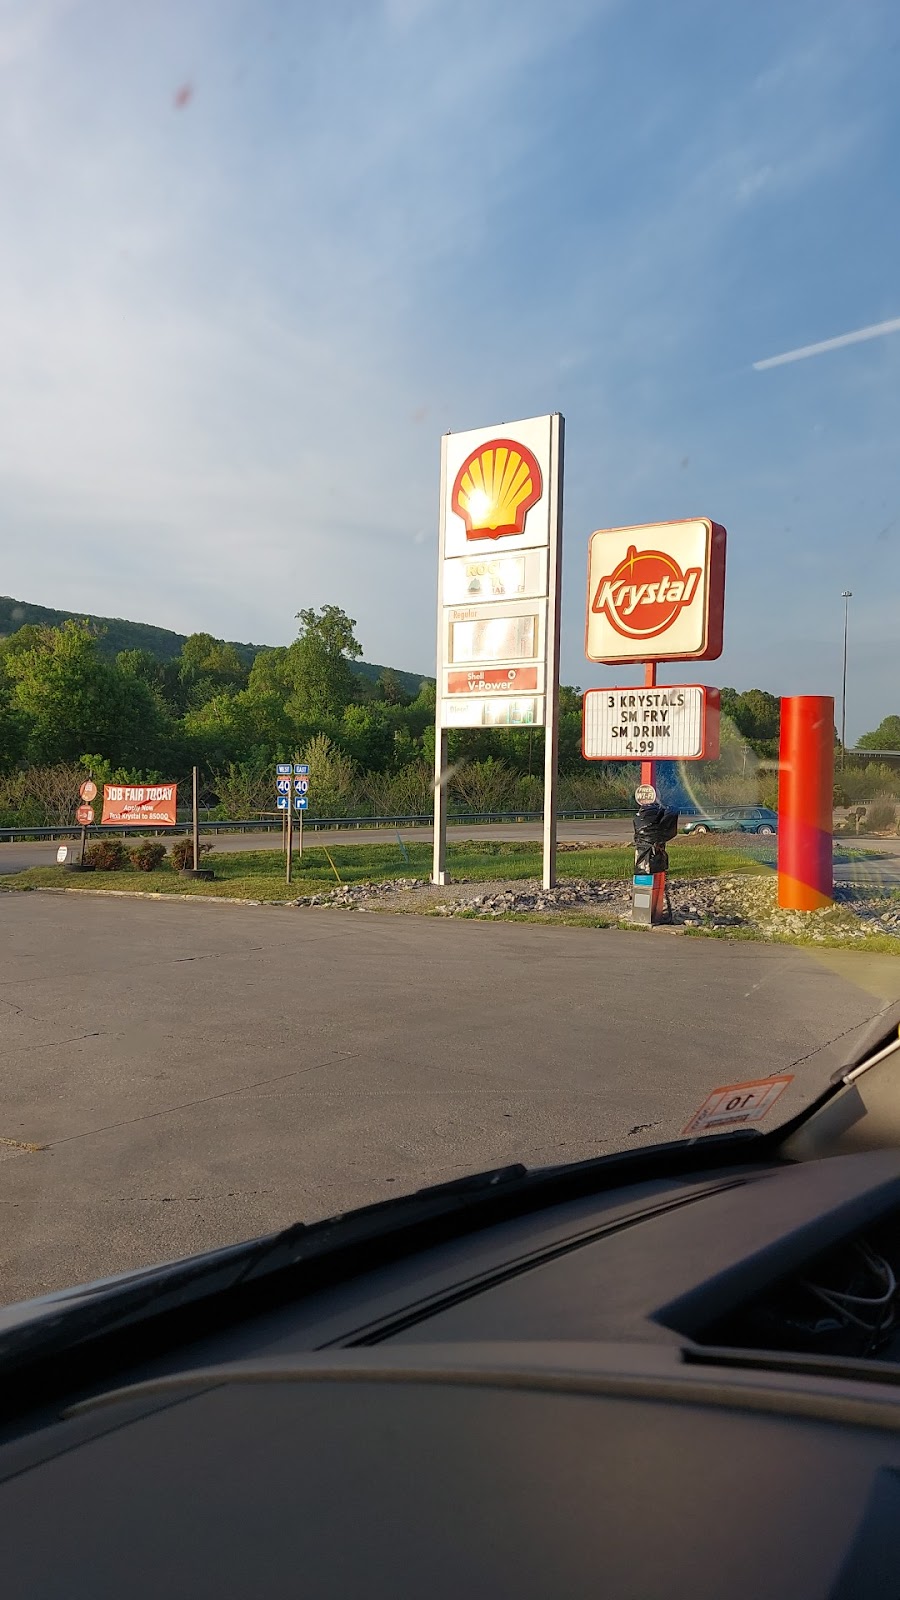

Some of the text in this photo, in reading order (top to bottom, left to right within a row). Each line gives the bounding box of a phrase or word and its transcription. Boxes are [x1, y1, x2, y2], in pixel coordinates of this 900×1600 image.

[598, 572, 699, 615] Krystal
[453, 609, 477, 620] Regular
[467, 671, 485, 680] Shell
[468, 681, 513, 691] V-Power
[608, 694, 684, 708] 3 KRYSTALS
[621, 710, 668, 723] SM FRY
[611, 725, 671, 738] SM DRINK
[626, 741, 654, 753] 4.99
[278, 781, 290, 791] 40
[296, 781, 308, 791] 40
[107, 788, 173, 800] JOB FAIR TODAY
[124, 804, 141, 812] Apply
[122, 812, 140, 820] Krystal
